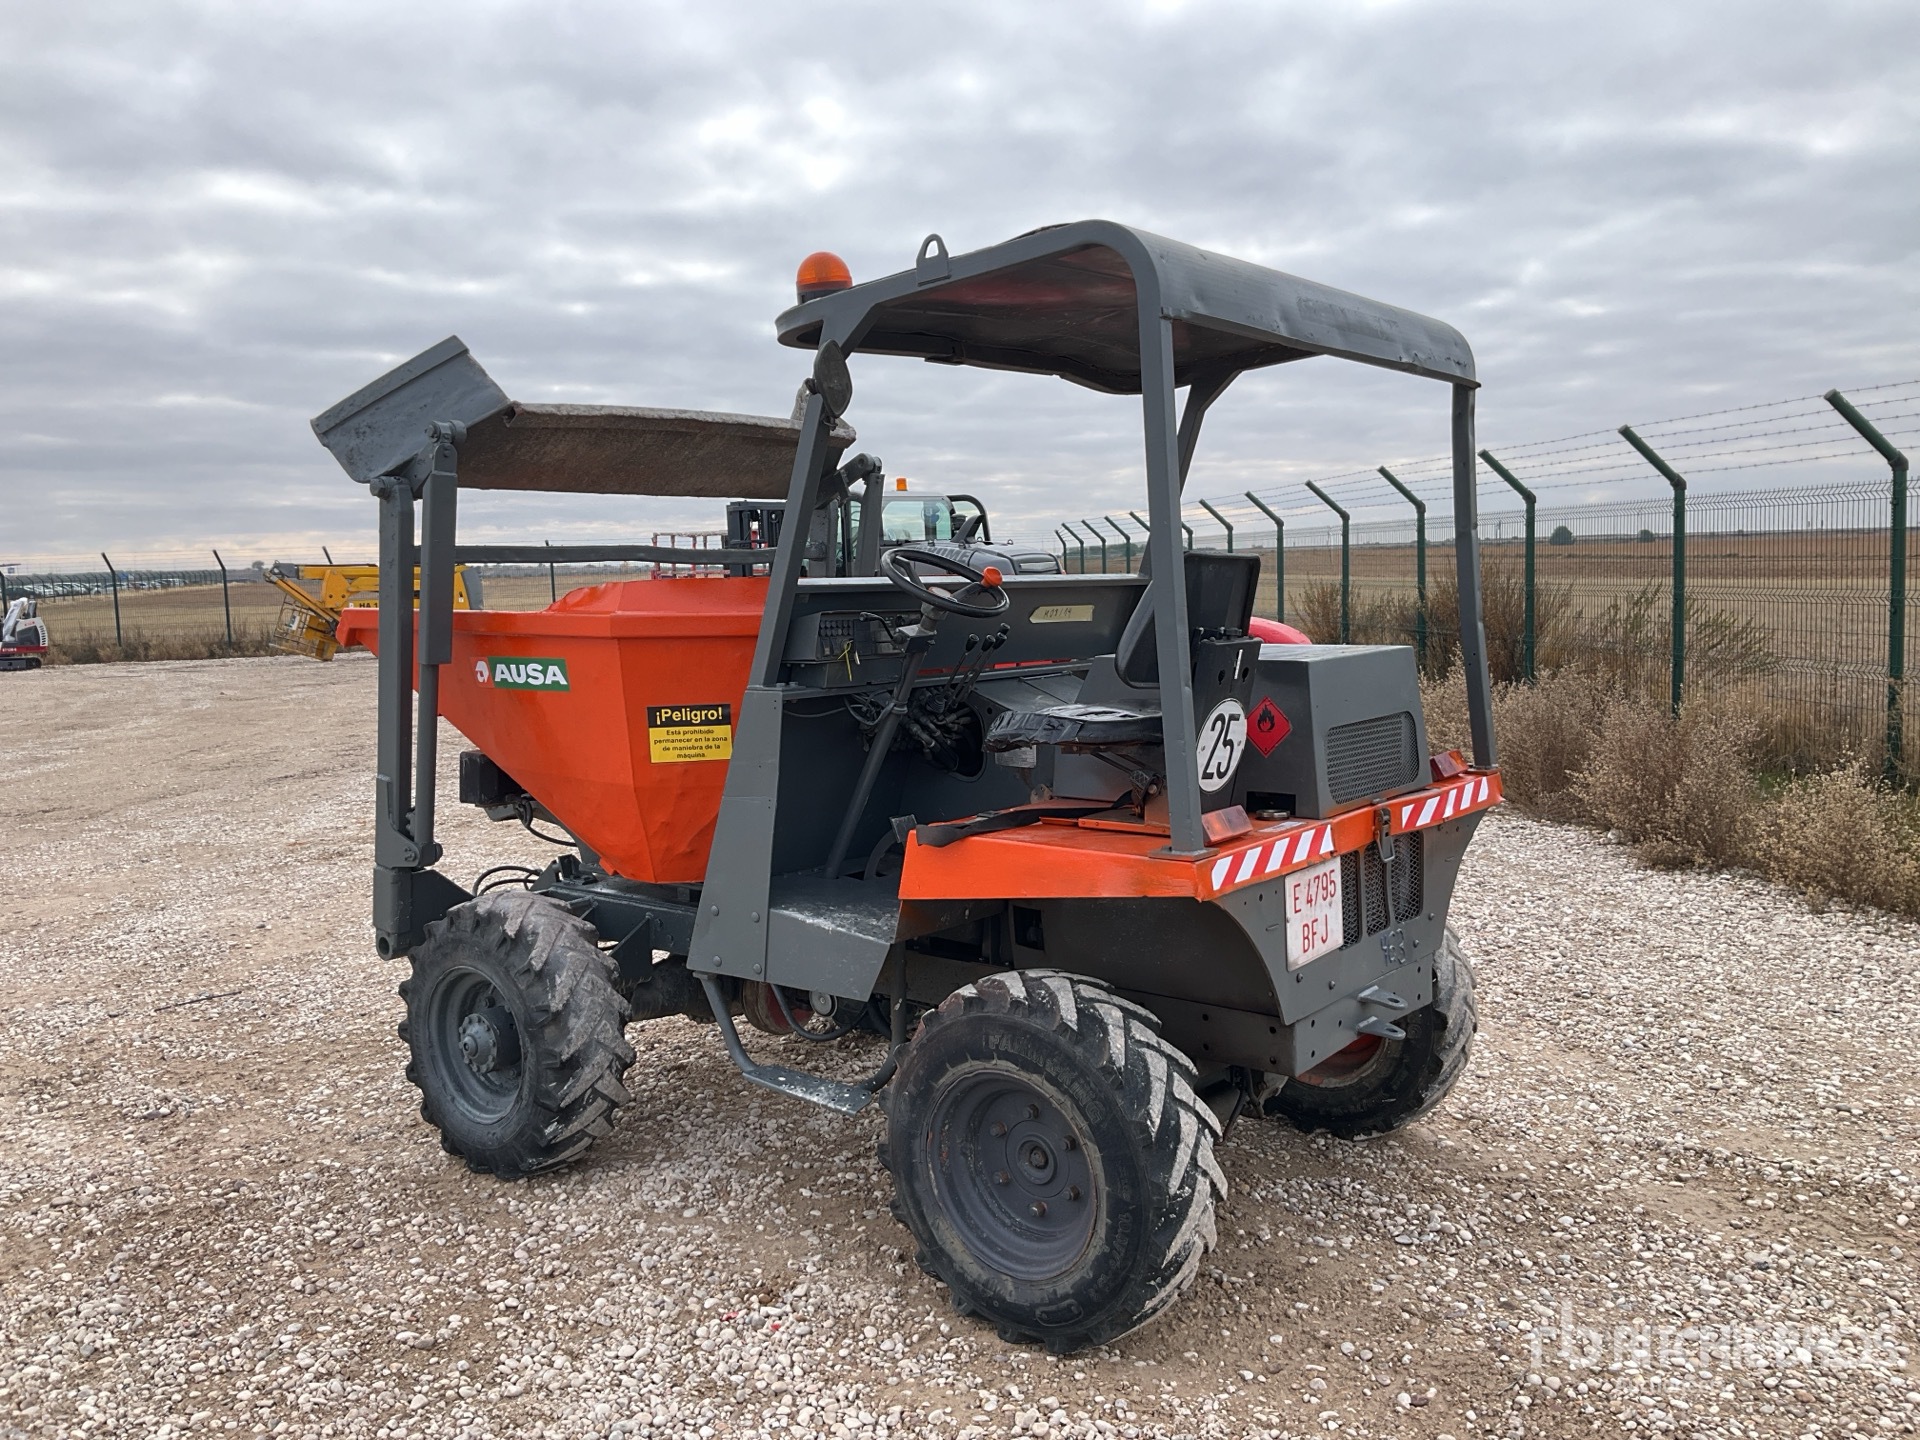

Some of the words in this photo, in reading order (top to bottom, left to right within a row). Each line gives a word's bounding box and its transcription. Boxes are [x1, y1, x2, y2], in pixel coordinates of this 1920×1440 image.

[494, 663, 568, 686] AUSA
[656, 706, 723, 725] ¡Peligro!
[654, 737, 693, 745] permanecer
[683, 728, 714, 736] prohibido
[1201, 712, 1241, 780] 25
[1293, 883, 1302, 914] E
[1306, 868, 1337, 908] 4795
[1302, 913, 1329, 954] BFJ
